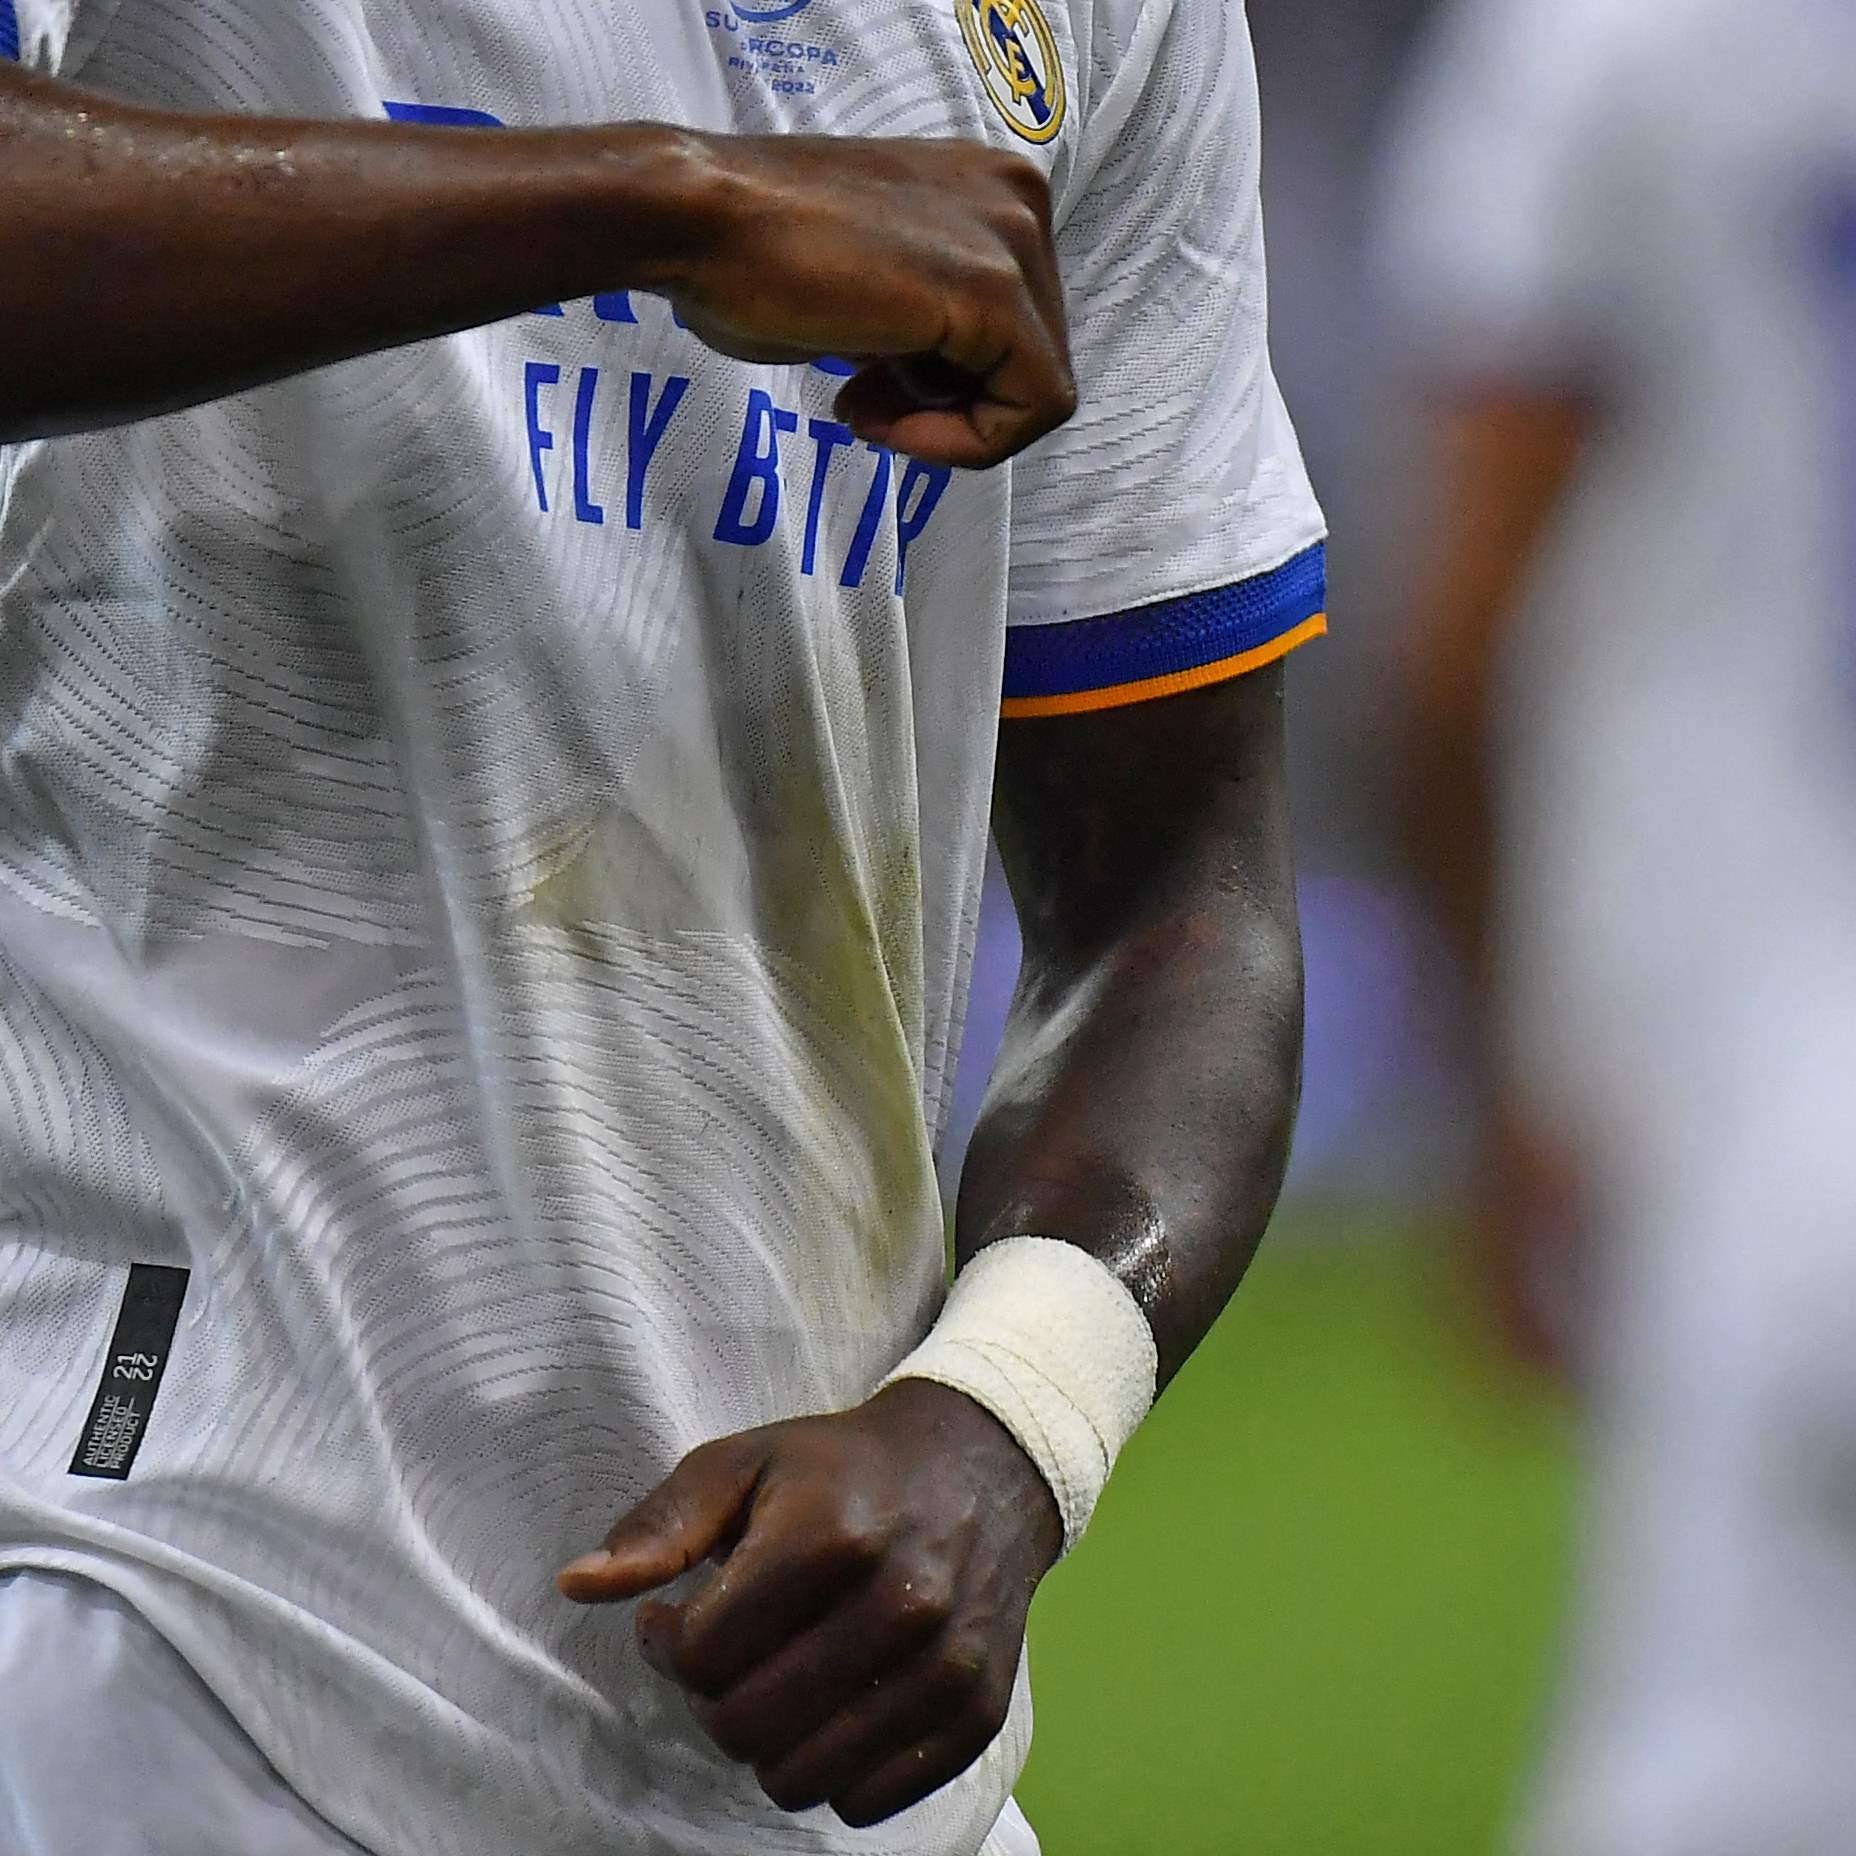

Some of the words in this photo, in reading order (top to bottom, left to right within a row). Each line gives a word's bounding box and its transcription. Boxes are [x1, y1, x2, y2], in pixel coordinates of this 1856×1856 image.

[525, 362, 689, 530] FLY
[113, 1353, 138, 1379] 21
[84, 1395, 118, 1465] AUTHENTIC
[95, 1406, 128, 1469] LICENSED
[108, 1411, 141, 1470] PRODUCT
